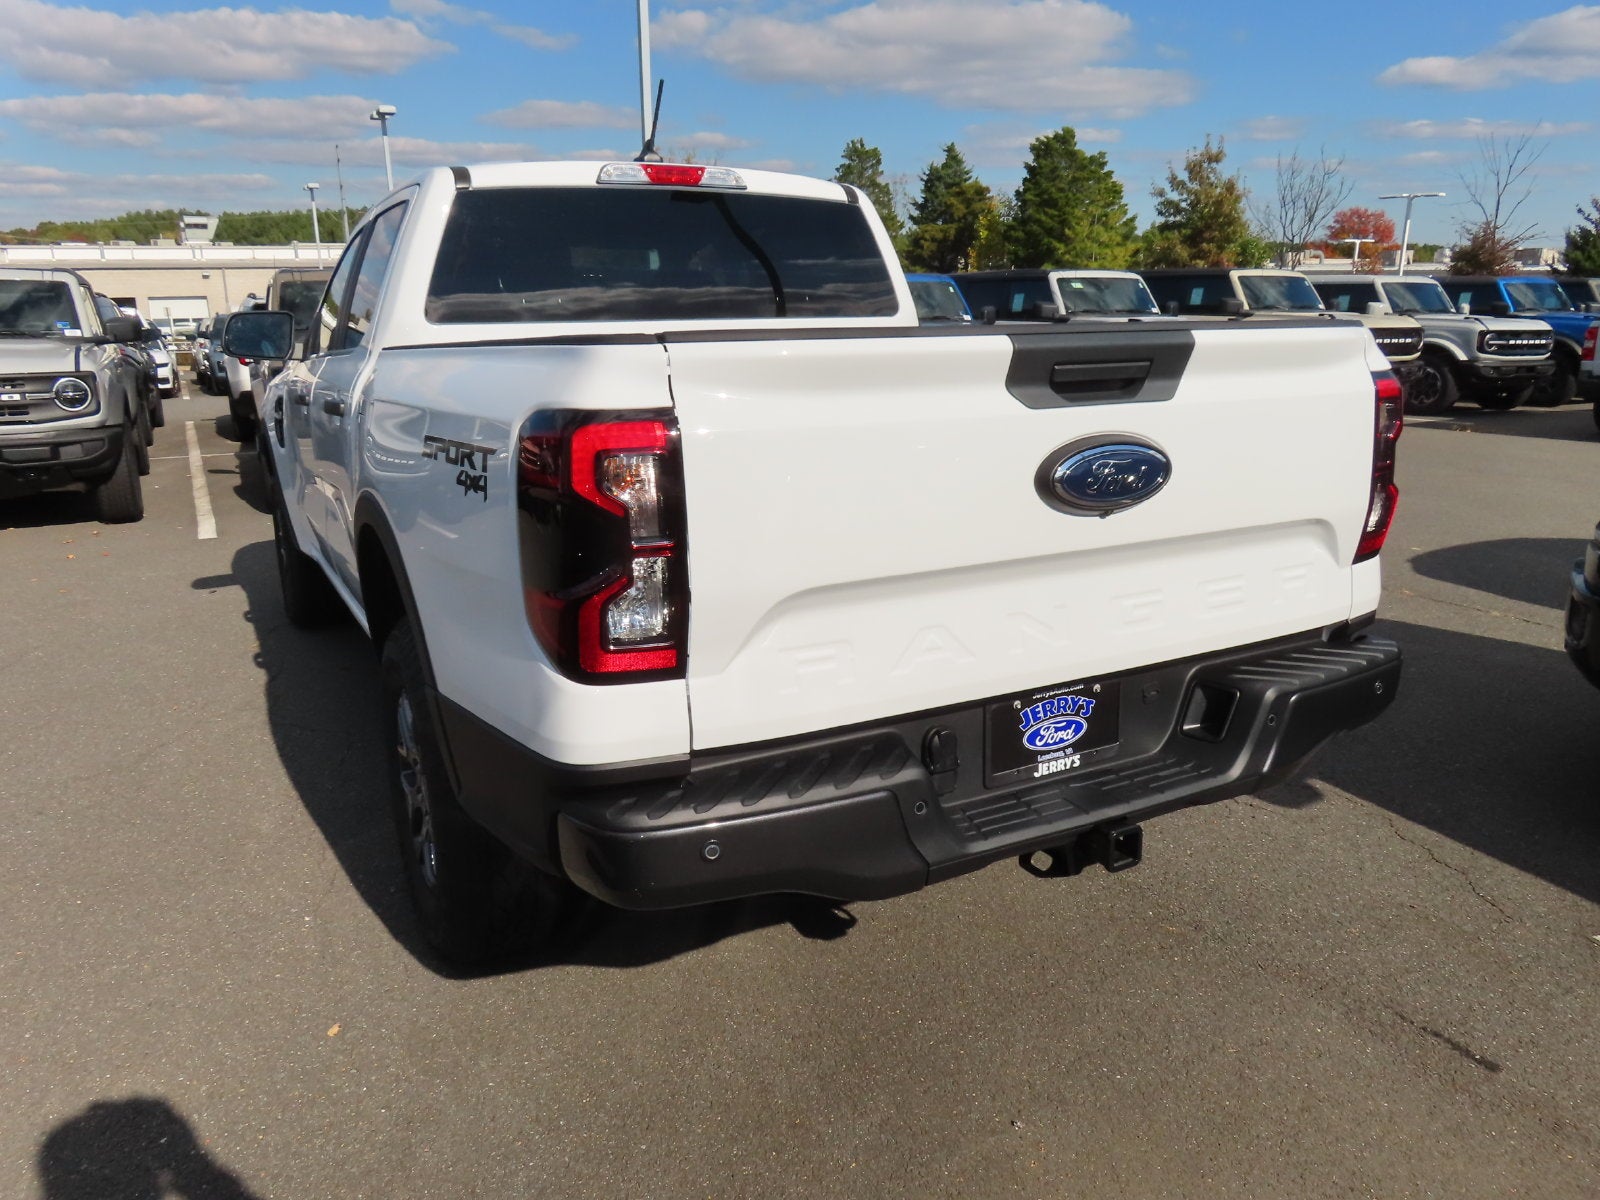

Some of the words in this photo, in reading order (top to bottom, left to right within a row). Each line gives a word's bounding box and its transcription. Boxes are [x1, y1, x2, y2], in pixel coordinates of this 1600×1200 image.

[421, 434, 498, 474] SPORT
[1086, 458, 1150, 494] Ford
[778, 563, 1320, 696] RANGER
[1019, 695, 1096, 731] JERRY'S
[1035, 721, 1076, 746] Ford
[1033, 754, 1081, 778] JERRY'S
